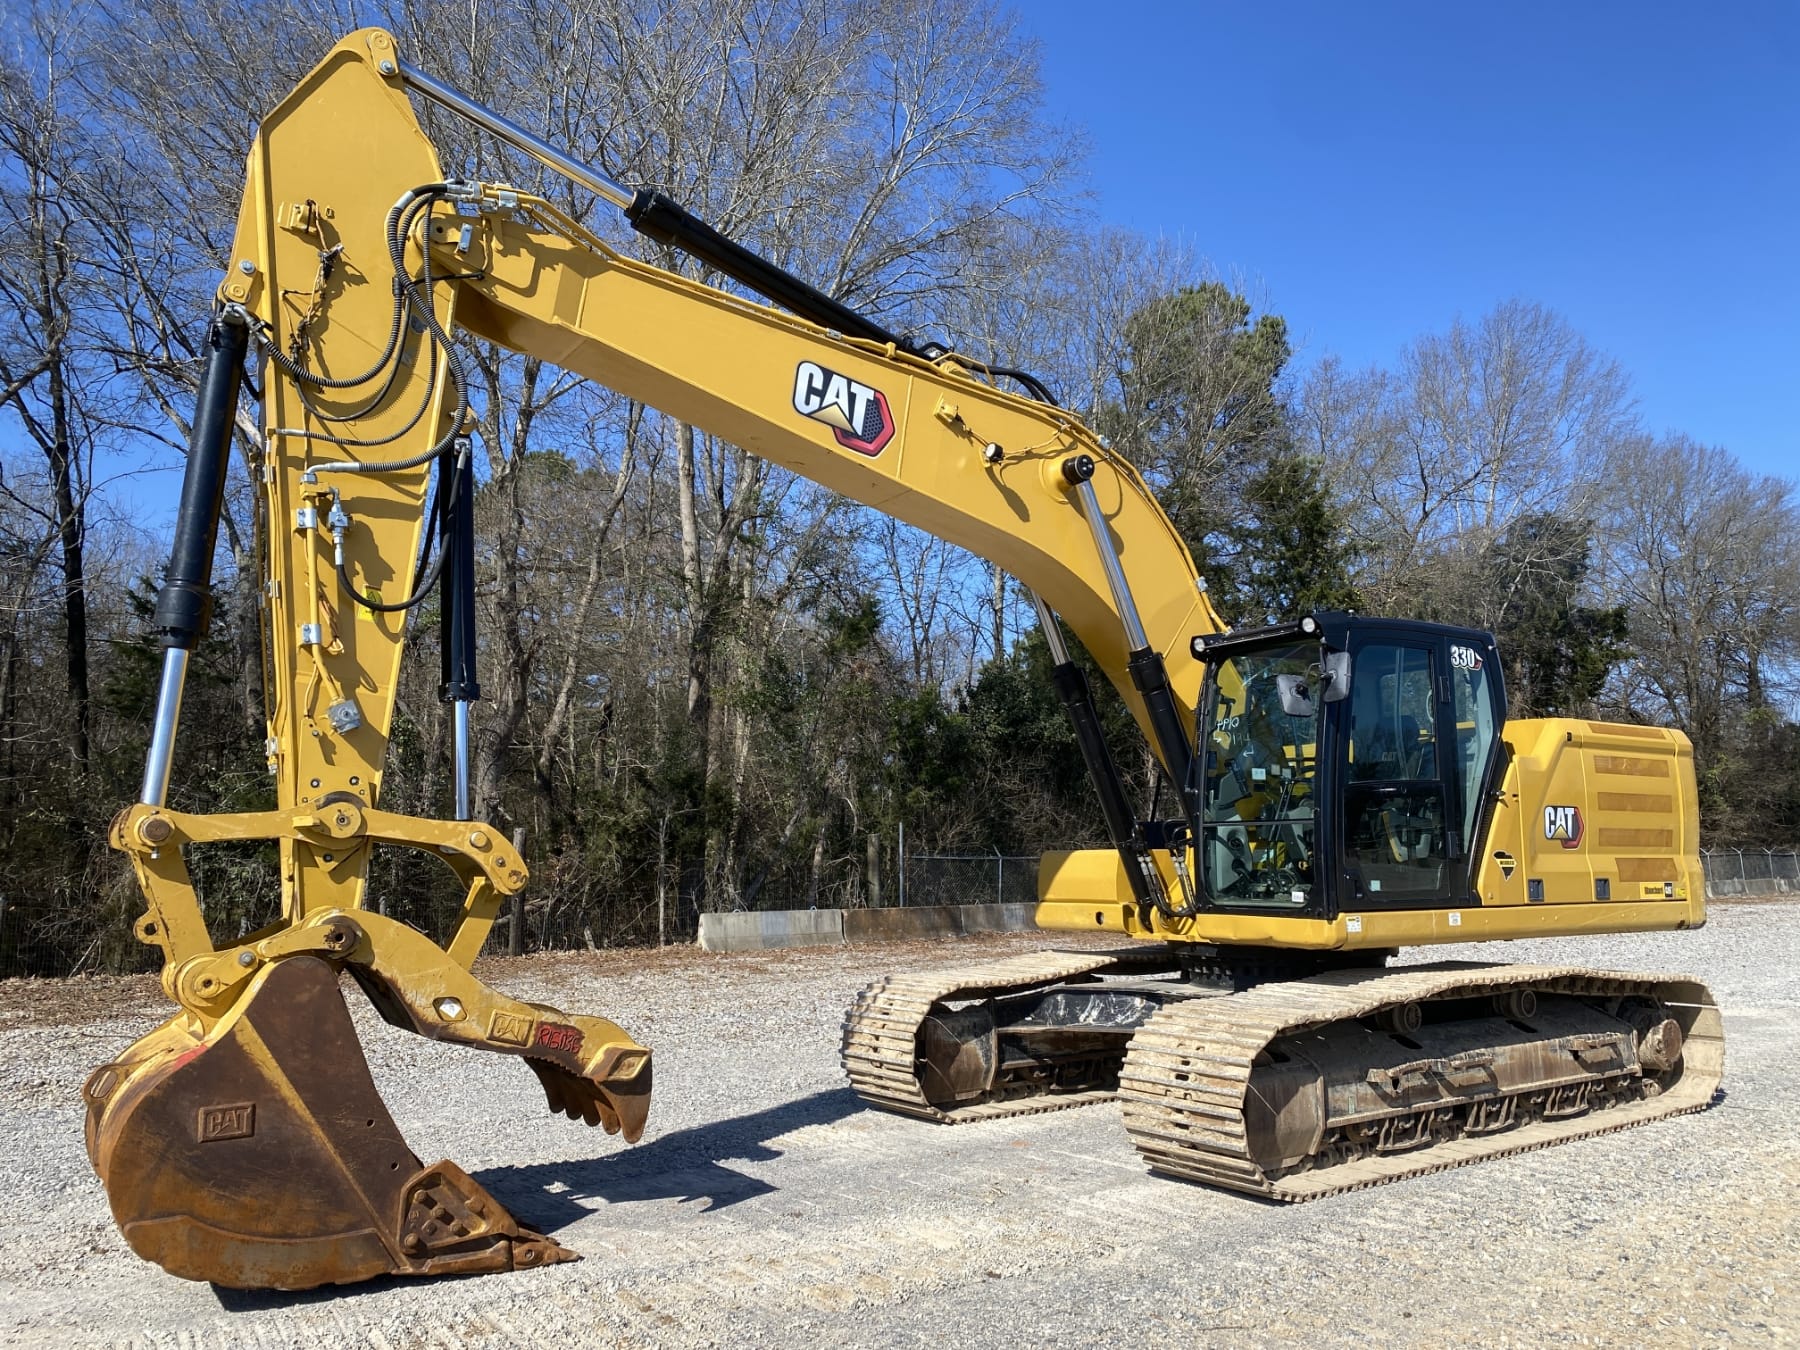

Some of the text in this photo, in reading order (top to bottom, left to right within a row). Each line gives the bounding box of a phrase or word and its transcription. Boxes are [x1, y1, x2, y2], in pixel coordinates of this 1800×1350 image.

[794, 361, 875, 436] CAT
[1450, 645, 1475, 668] 330
[1544, 806, 1575, 839] CAT
[492, 1014, 532, 1045] CAT
[206, 1109, 251, 1137] CAT
